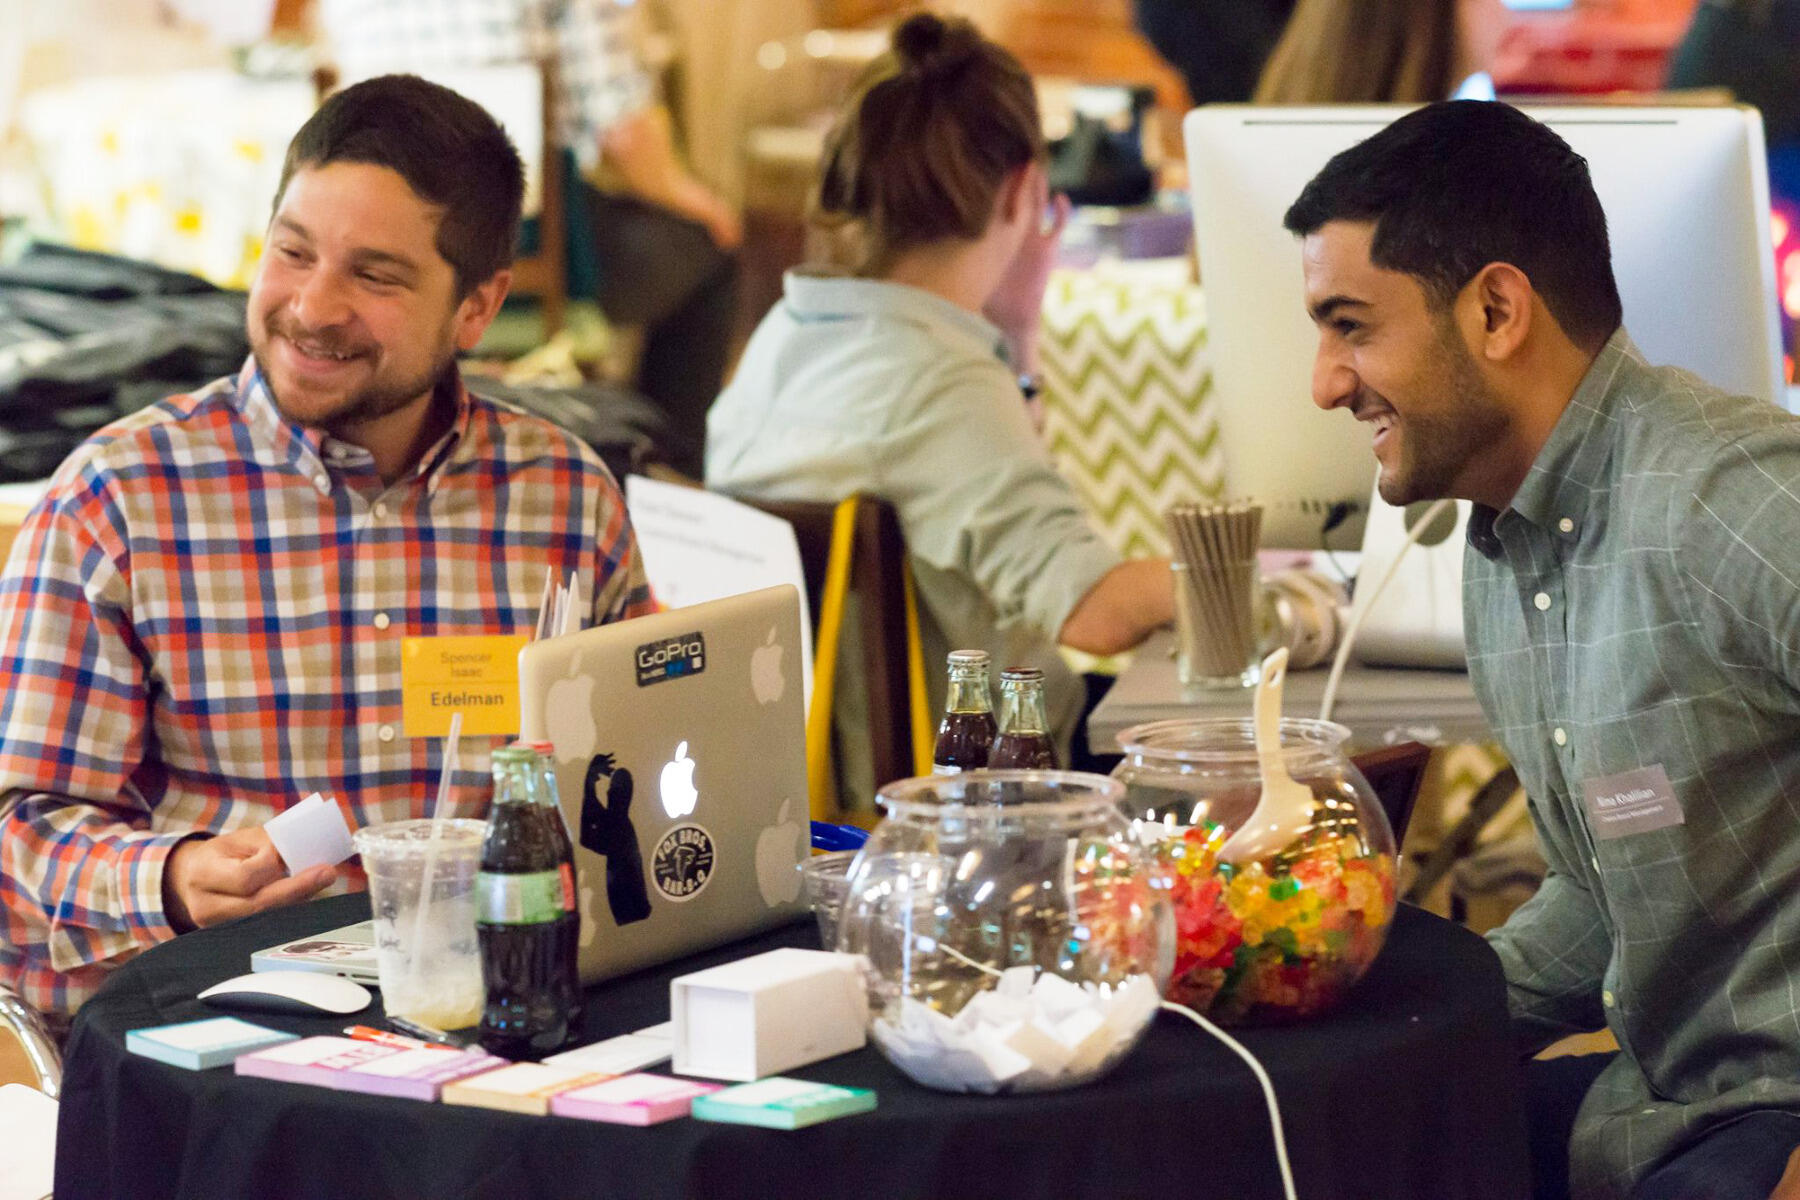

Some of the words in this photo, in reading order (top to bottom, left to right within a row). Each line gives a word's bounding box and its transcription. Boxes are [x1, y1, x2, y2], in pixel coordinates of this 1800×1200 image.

[441, 652, 492, 665] Spencer
[638, 641, 701, 668] GoPro
[431, 691, 504, 706] Edelman
